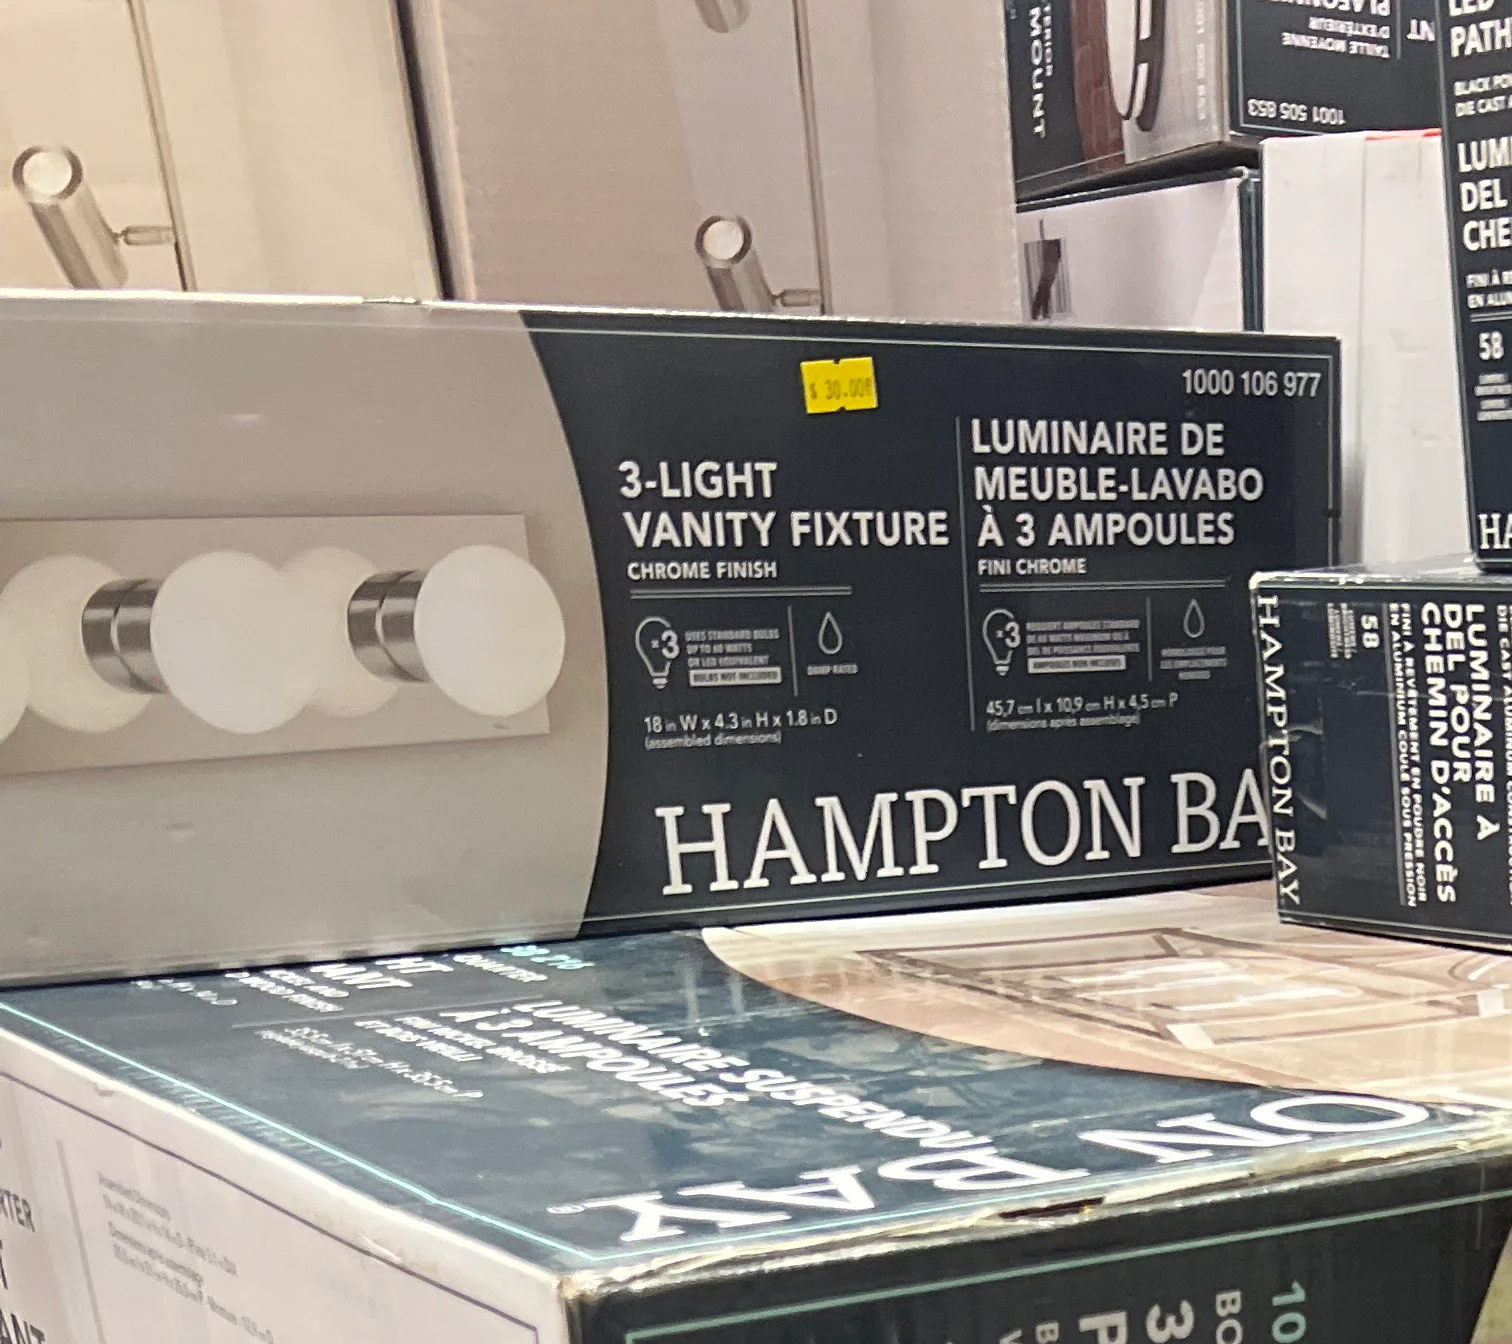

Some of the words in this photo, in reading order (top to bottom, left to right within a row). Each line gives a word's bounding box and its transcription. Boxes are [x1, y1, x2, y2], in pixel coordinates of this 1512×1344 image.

[1030, 8, 1046, 139] MOUNT
[1312, 107, 1346, 126] 1001
[1461, 179, 1507, 212] DEL
[1479, 331, 1503, 360] 58
[1182, 369, 1234, 395] 1000
[1240, 371, 1278, 397] 106
[1282, 373, 1321, 398] 977
[971, 418, 1167, 457] LUMINAIRE
[1181, 422, 1224, 456] DE
[619, 461, 777, 500] 3-LIGHT
[975, 466, 1263, 502] MEUBLE-LAVABO
[625, 510, 775, 549] VANITY
[790, 510, 949, 547] FIXTURE
[979, 504, 1004, 547] À
[1017, 513, 1035, 547] 3
[1048, 512, 1235, 547] AMPOULES
[628, 561, 710, 581] CHROME
[716, 560, 777, 579] FINISH
[979, 559, 1011, 576] FINI
[1016, 558, 1086, 575] CHROME
[1361, 615, 1380, 649] 58
[1444, 604, 1466, 672] DEL
[1421, 602, 1449, 747] CHEMIN
[1257, 594, 1294, 817] HAMPTON
[1466, 604, 1495, 803] LUMINAIRE
[1450, 684, 1471, 783] POUR
[656, 777, 1144, 895] HAMPTON
[1170, 768, 1272, 855] BA
[1476, 814, 1500, 840] À
[1274, 828, 1300, 904] BAY
[512, 1000, 749, 1072] LUMINAIRE
[502, 1030, 749, 1107] AMPOULES
